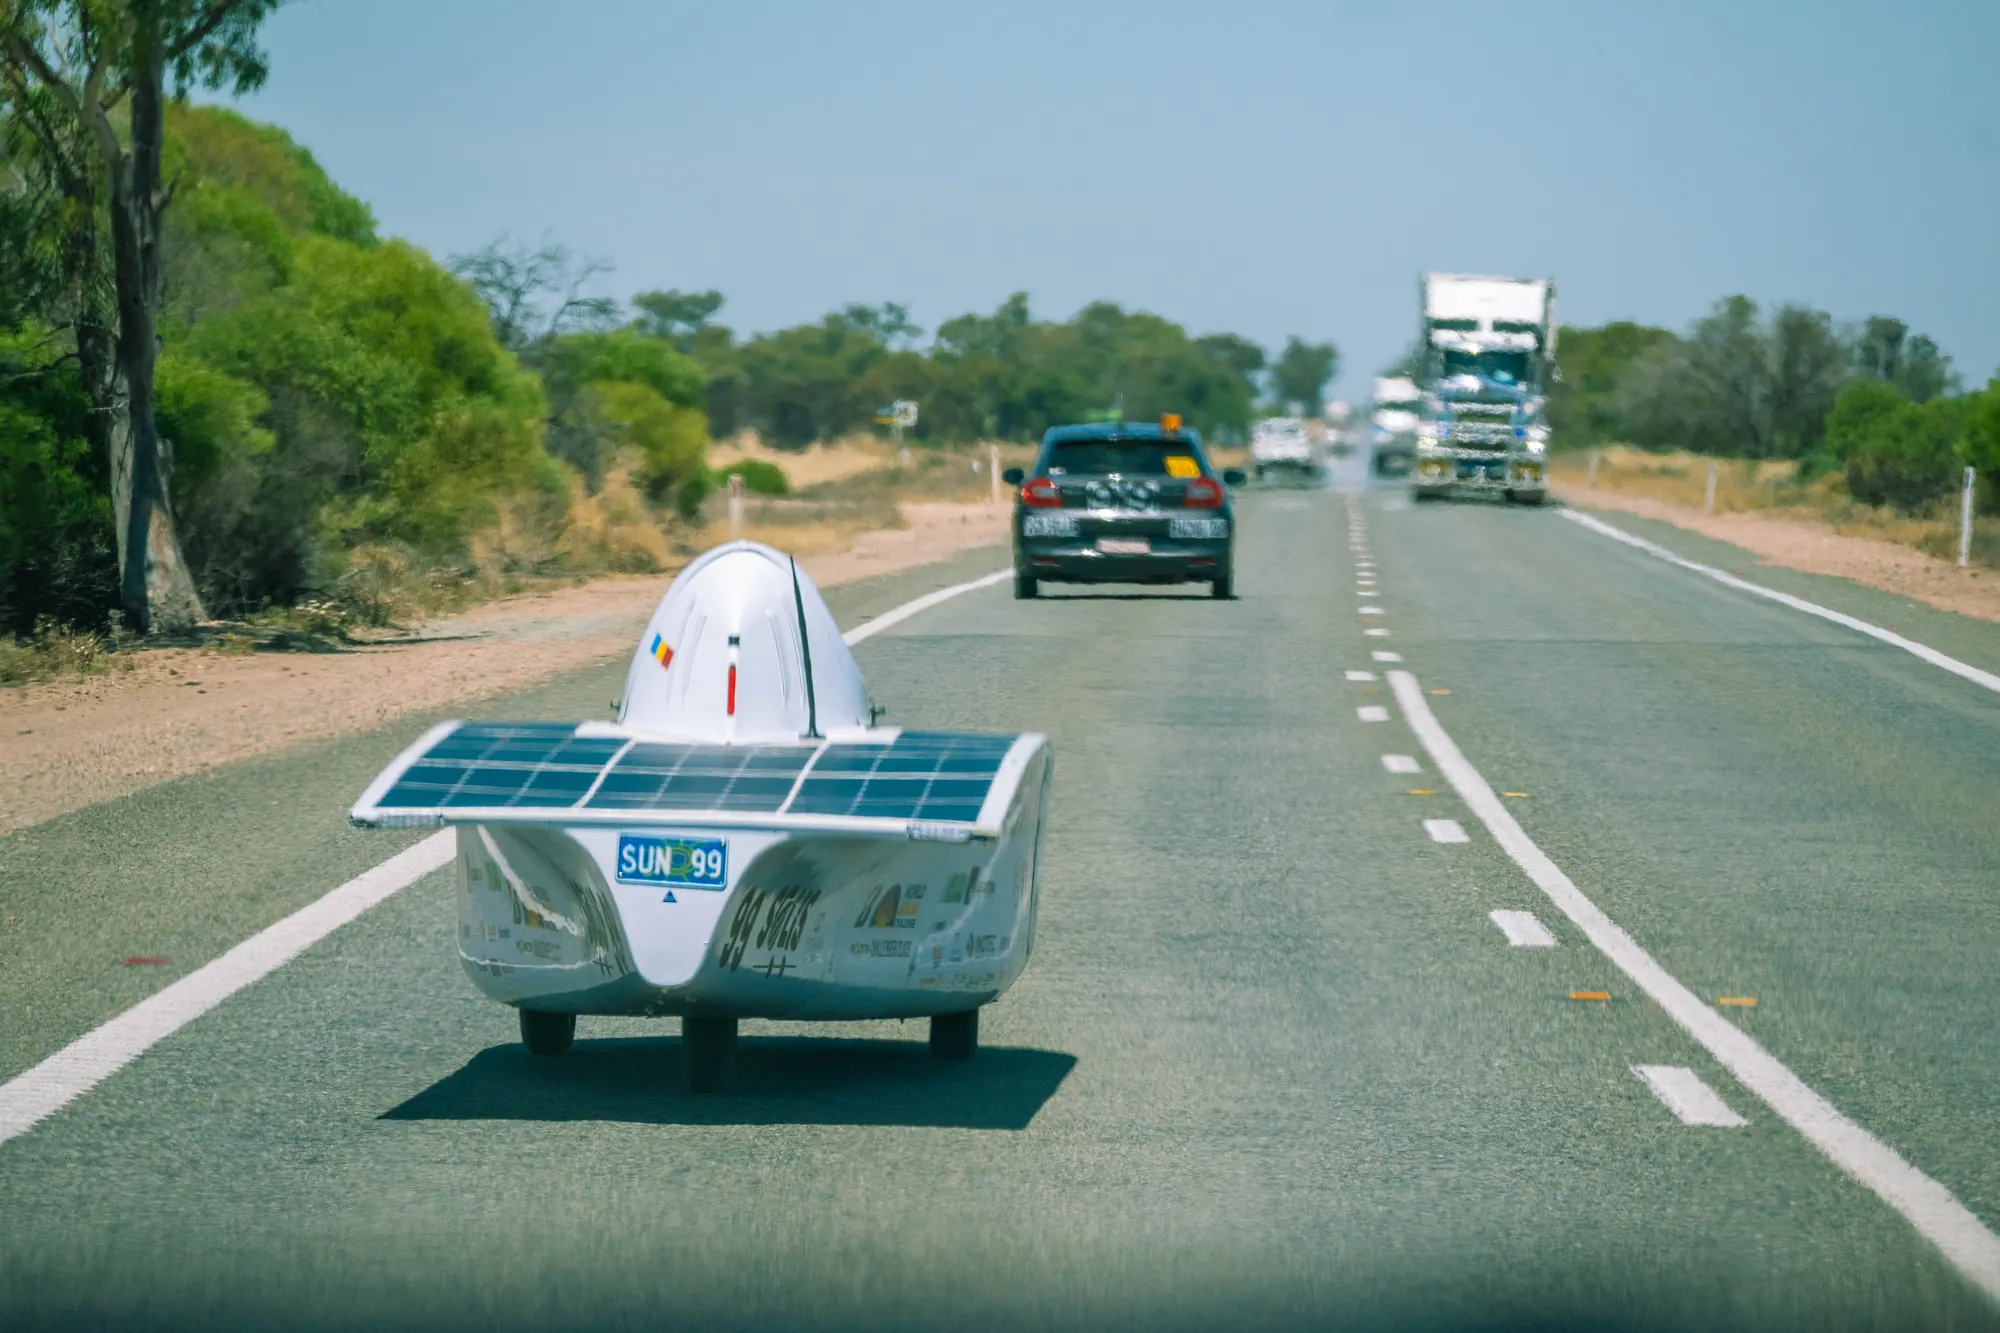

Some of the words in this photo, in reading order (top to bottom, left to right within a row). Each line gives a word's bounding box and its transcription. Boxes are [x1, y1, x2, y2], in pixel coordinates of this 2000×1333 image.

[622, 843, 672, 876] SUN
[691, 848, 722, 878] 99
[719, 887, 765, 973] 99
